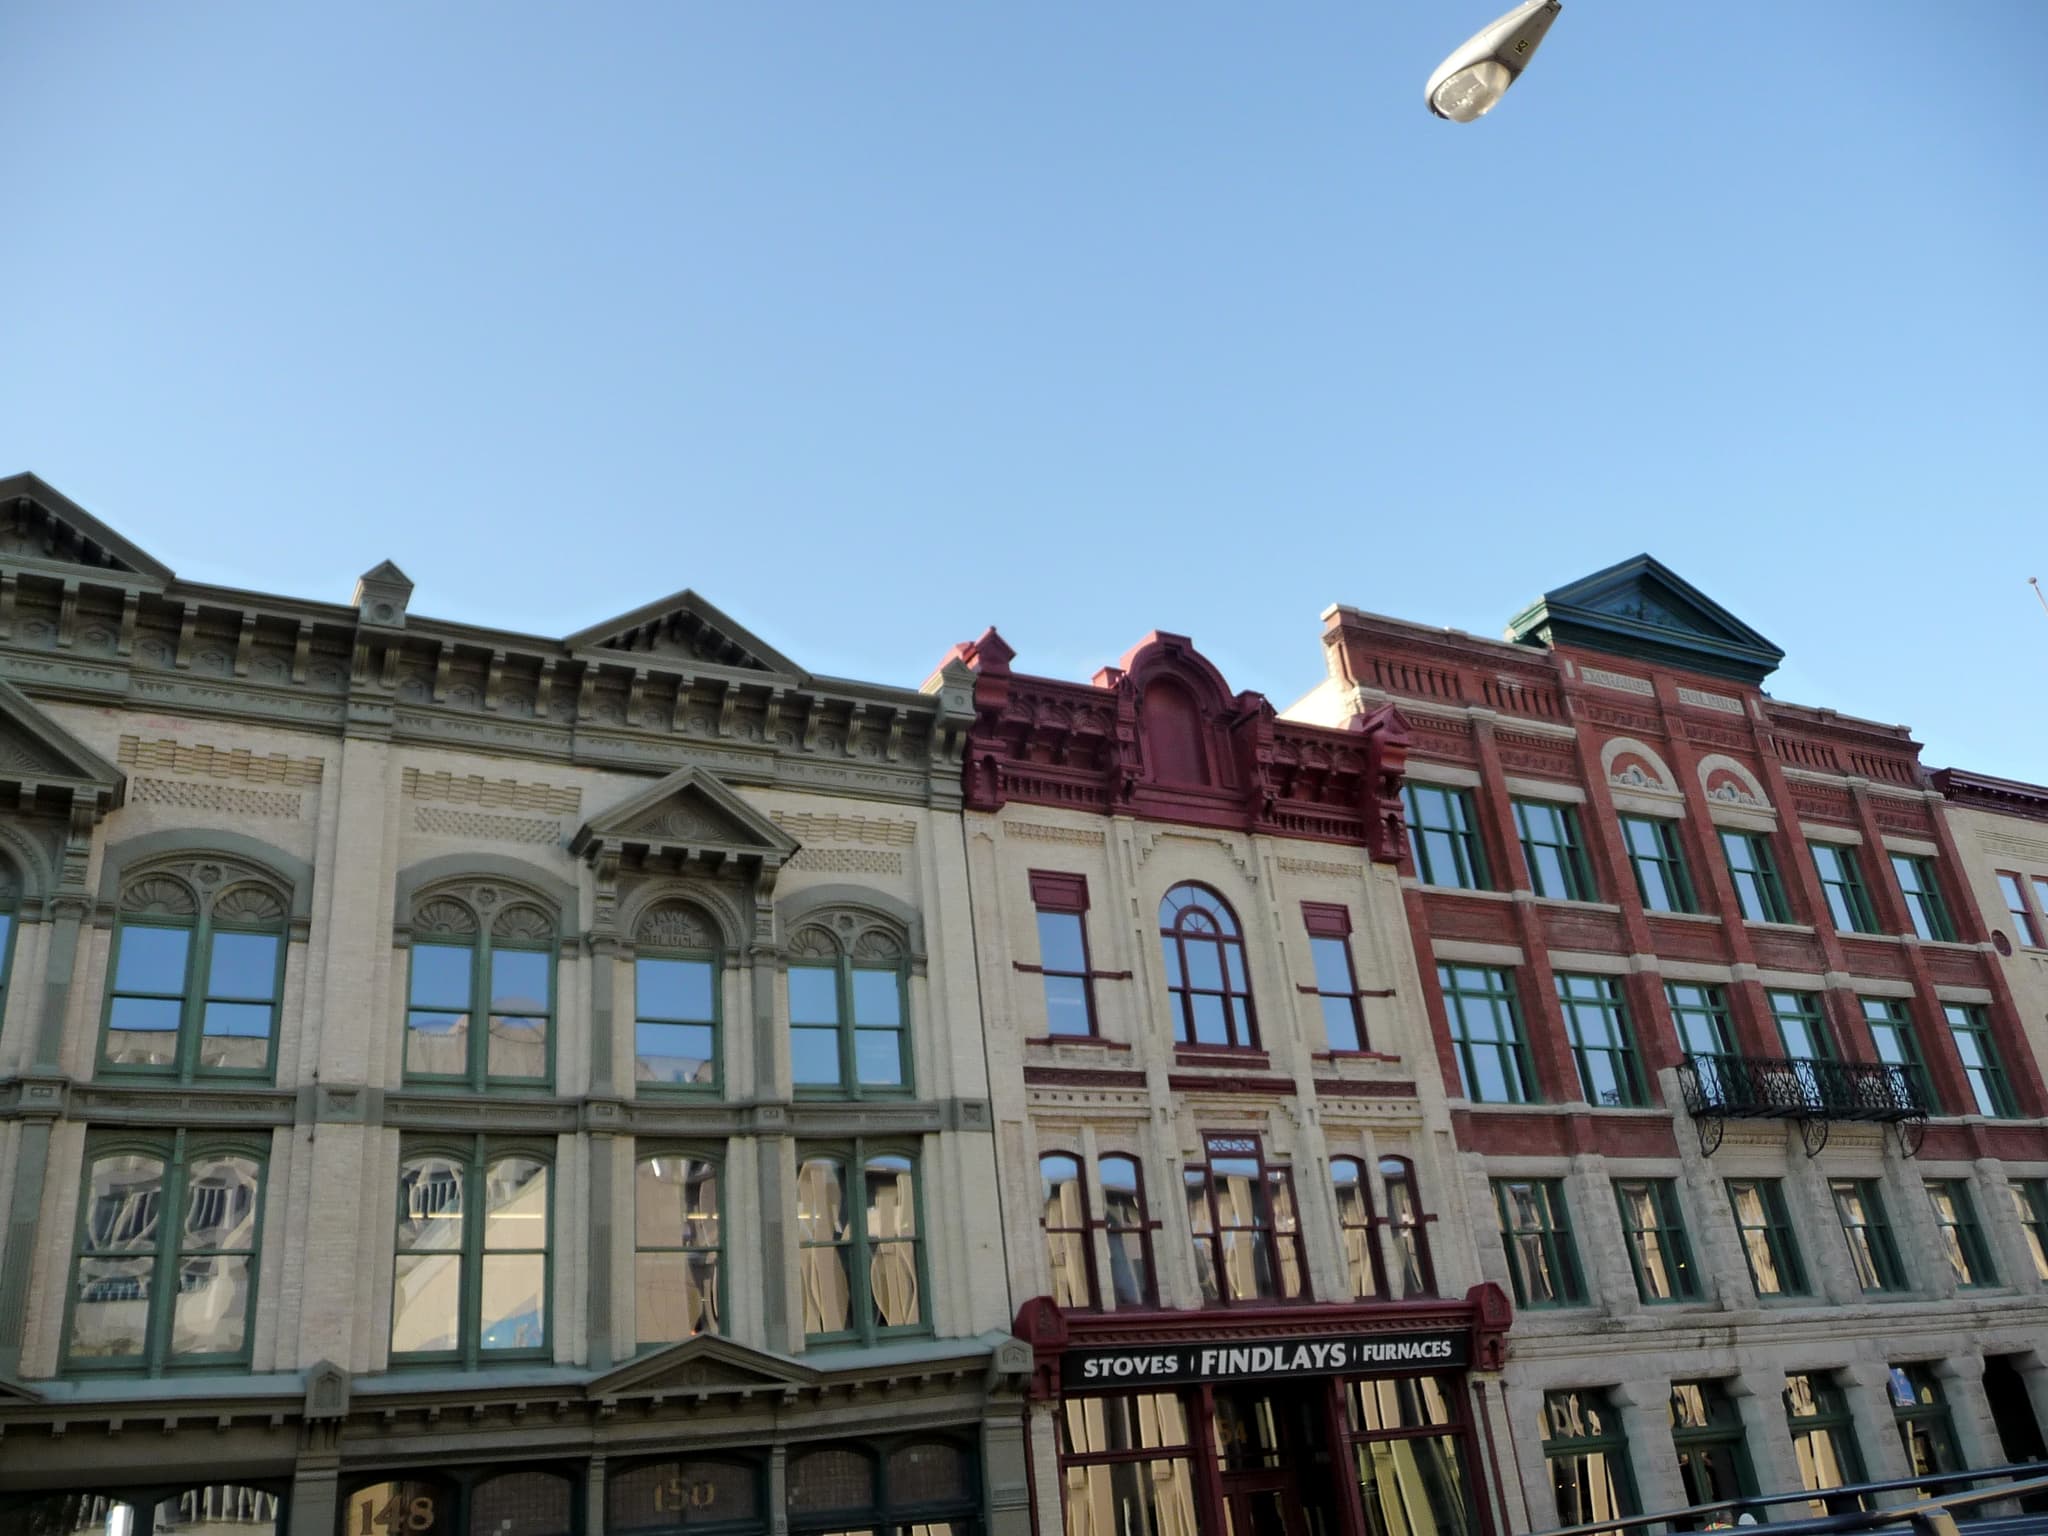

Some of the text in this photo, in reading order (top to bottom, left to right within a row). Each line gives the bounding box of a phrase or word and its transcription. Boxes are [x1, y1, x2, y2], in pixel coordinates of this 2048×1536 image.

[1083, 1340, 1452, 1378] STOVES FINDLAYS FURNACES
[654, 1479, 716, 1513] 150
[360, 1496, 434, 1535] 148
